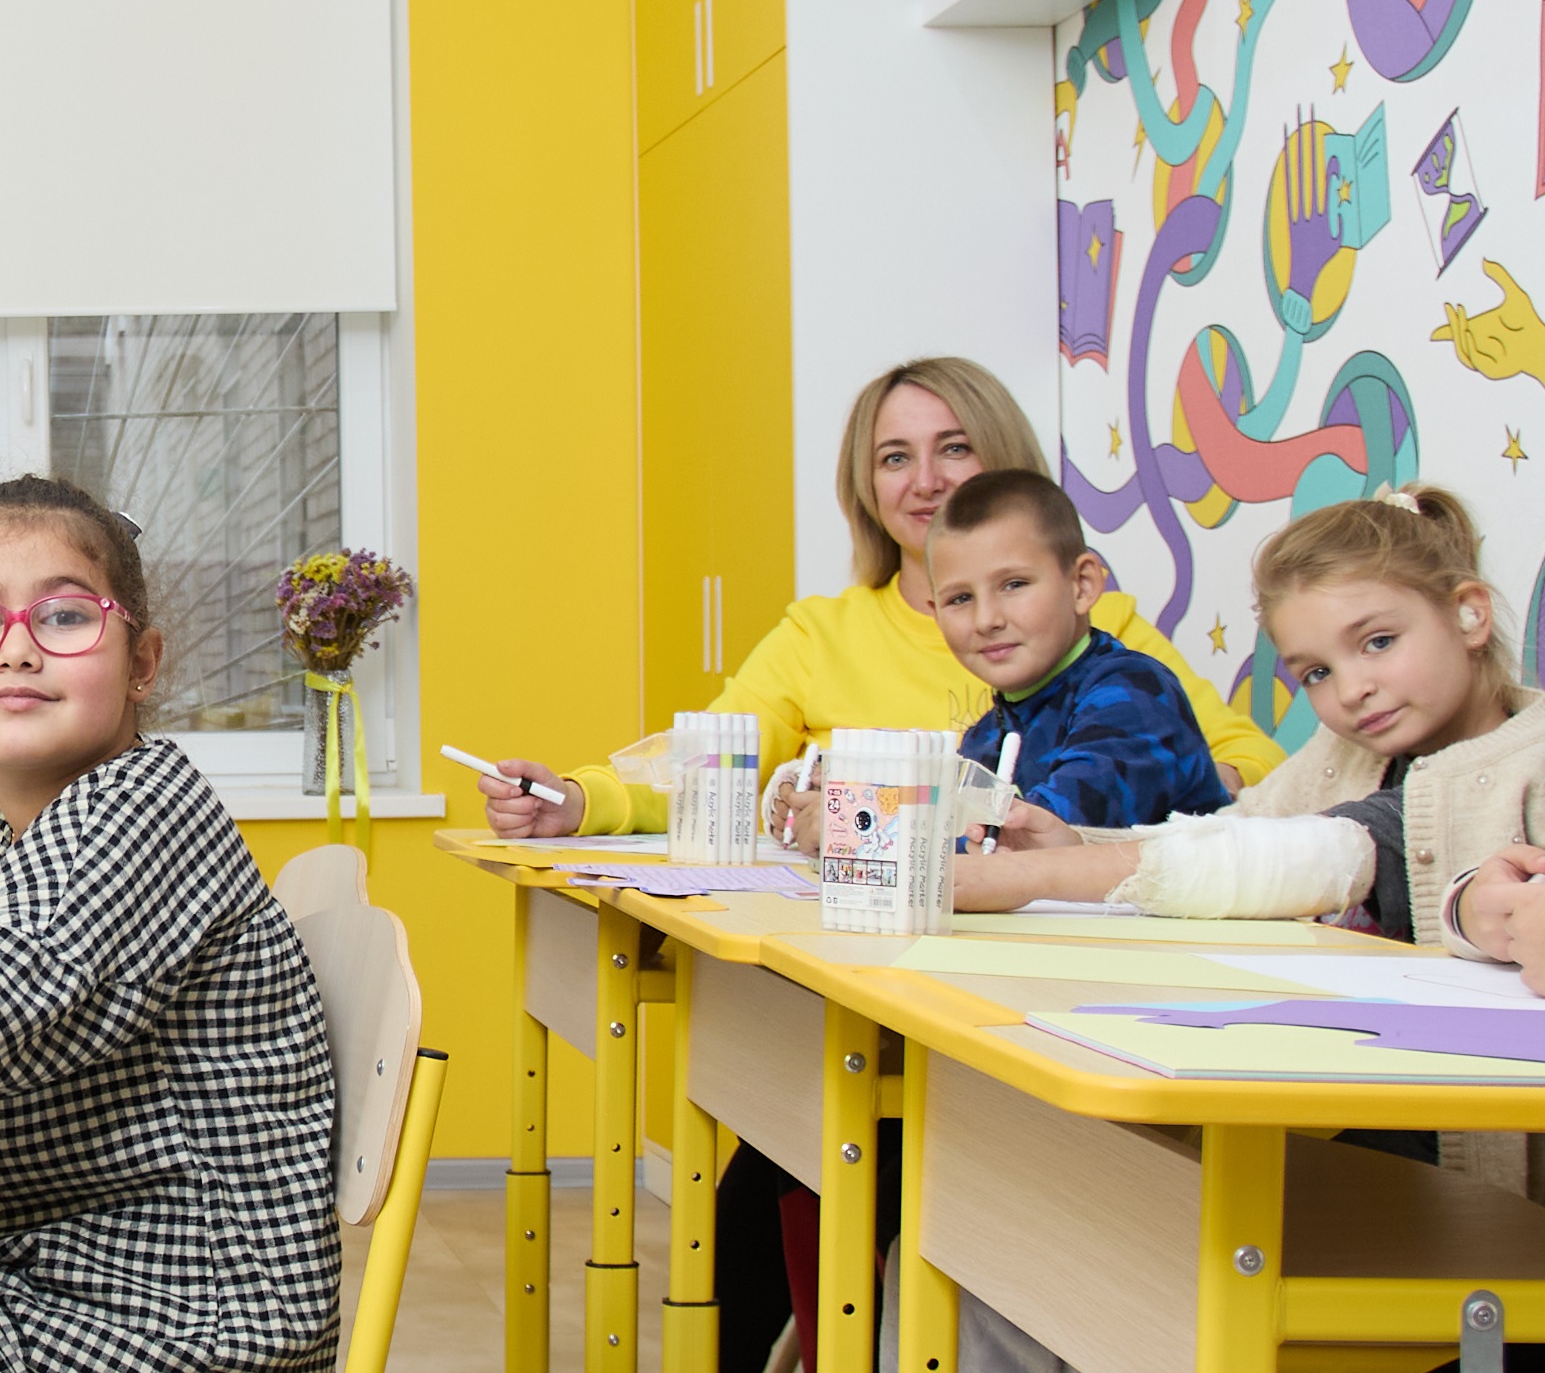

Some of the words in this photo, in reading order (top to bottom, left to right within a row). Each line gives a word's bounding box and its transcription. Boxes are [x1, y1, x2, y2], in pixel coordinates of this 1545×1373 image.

[908, 836, 917, 873] Acrylic
[918, 837, 928, 872] Acrylic
[939, 837, 949, 873] Acrylic
